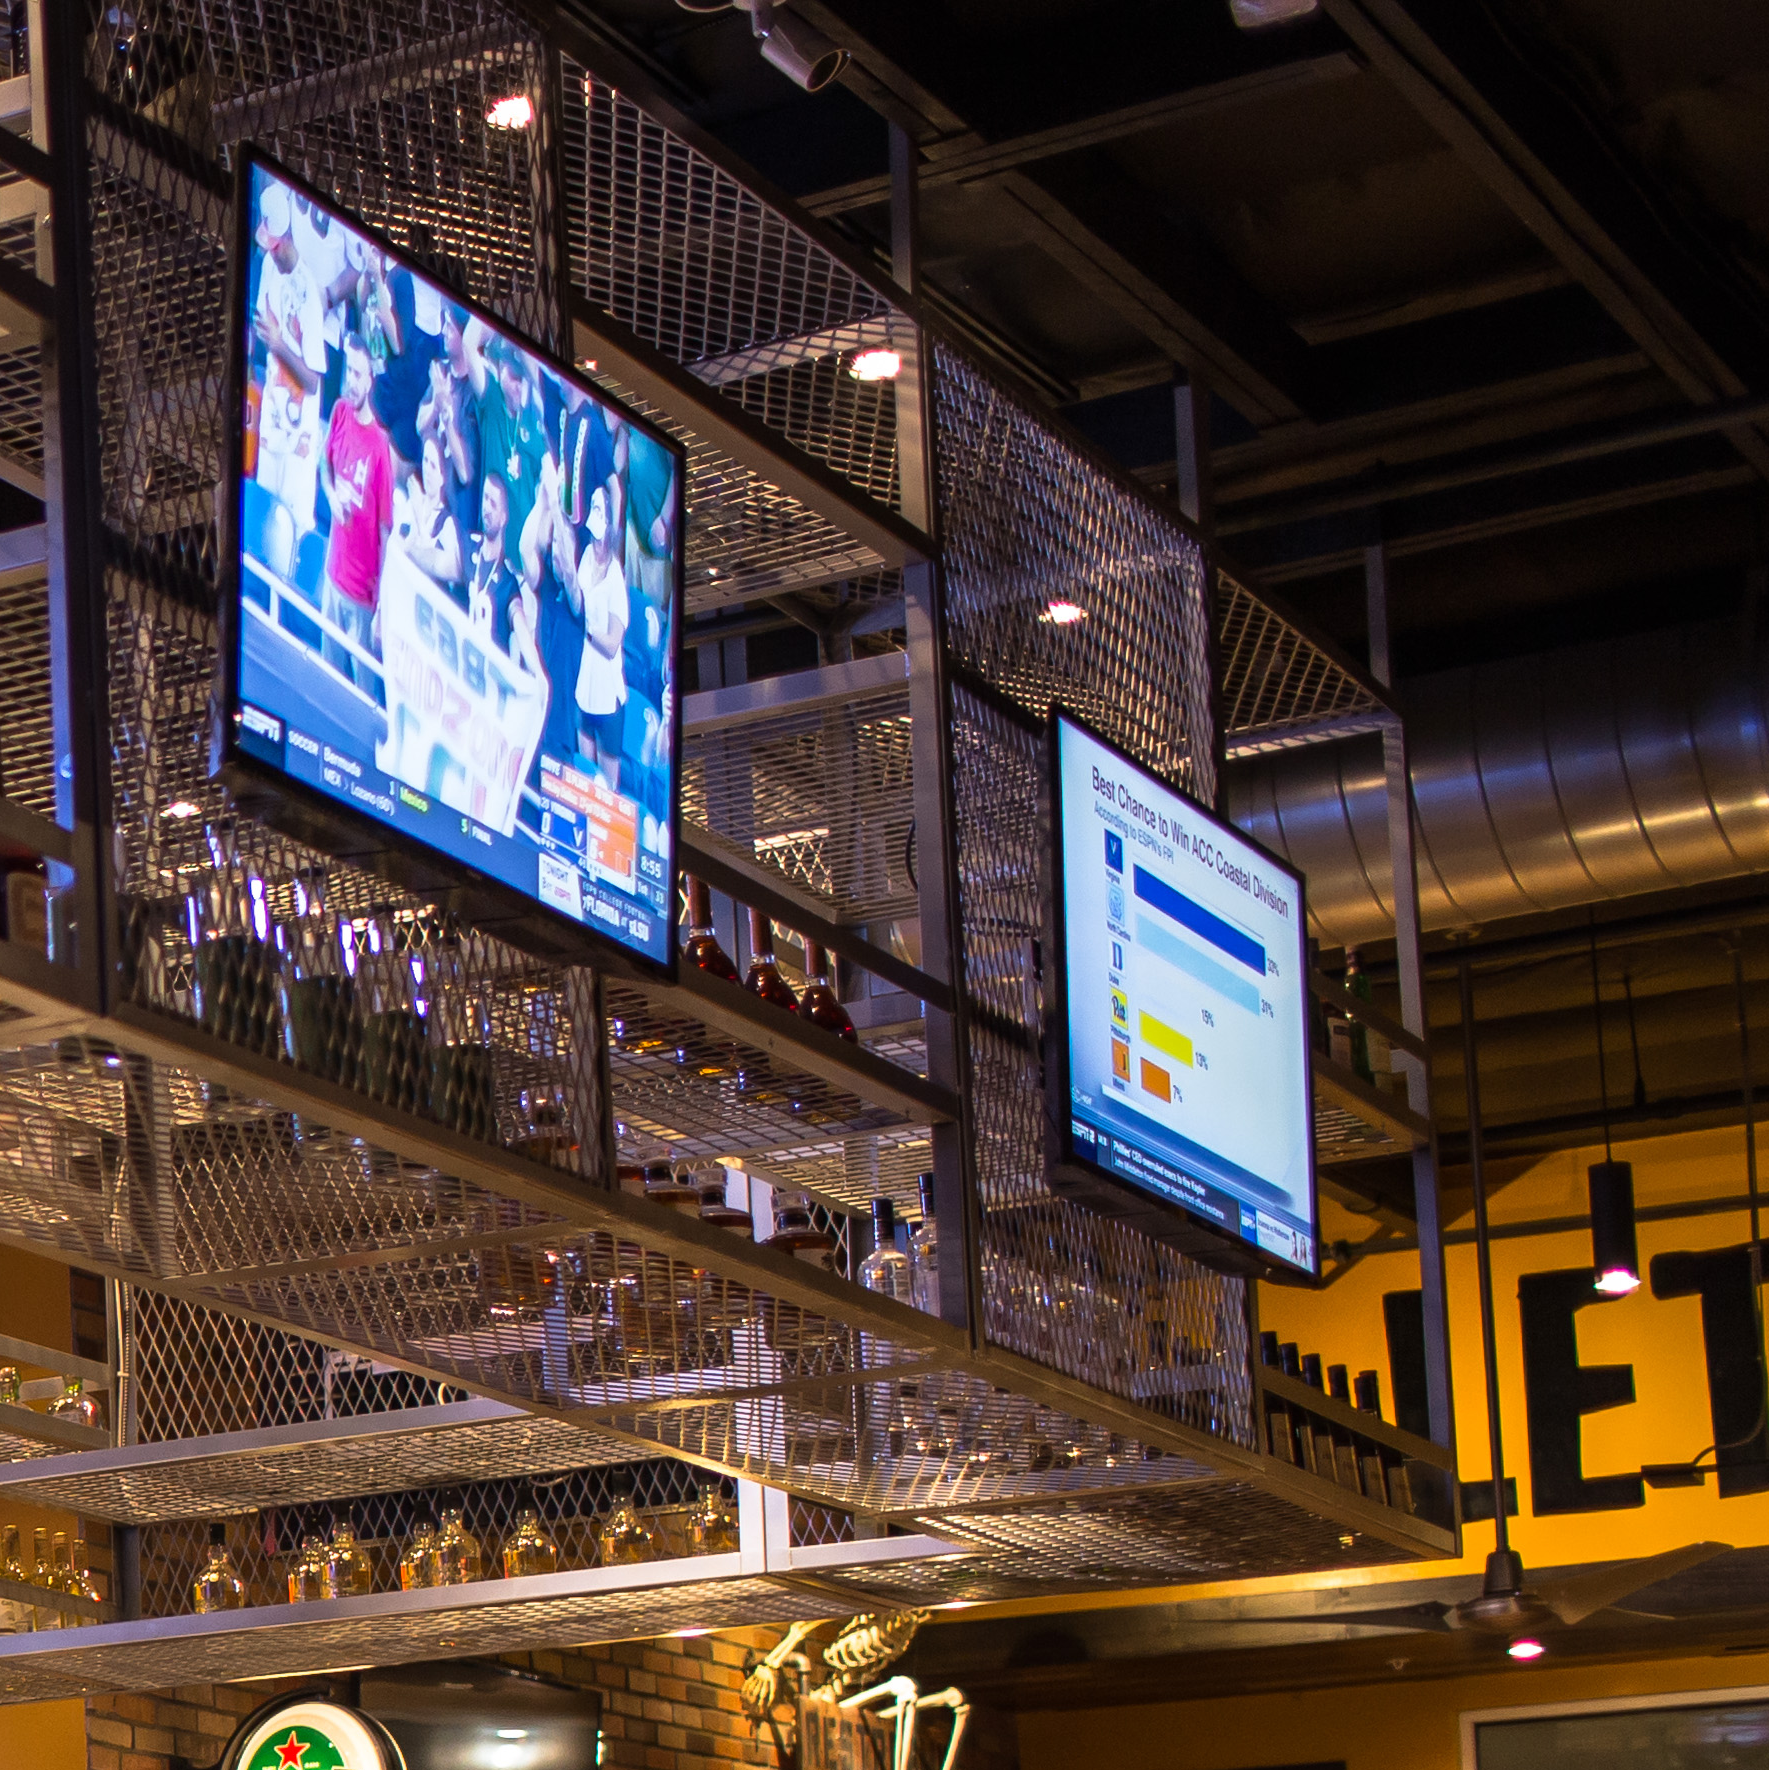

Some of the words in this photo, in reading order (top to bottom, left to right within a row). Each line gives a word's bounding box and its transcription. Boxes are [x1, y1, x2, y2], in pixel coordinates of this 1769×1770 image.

[1092, 765, 1116, 801] Best
[1117, 783, 1157, 830] Chance
[1158, 811, 1168, 838] to
[1170, 818, 1190, 852] Win
[1192, 834, 1214, 869] ACC
[1215, 850, 1251, 893] Coastal
[1253, 874, 1289, 919] Division
[1094, 800, 1129, 840] According
[1130, 823, 1137, 841] to
[1138, 829, 1162, 858] ESPN's
[1163, 843, 1175, 865] FPI
[640, 855, 661, 878] 8:55
[1105, 866, 1121, 885] Virginia
[1201, 1007, 1214, 1028] 15%
[1261, 998, 1274, 1019] 31%
[1195, 1051, 1209, 1071] 13%
[1173, 1083, 1183, 1104] 7%
